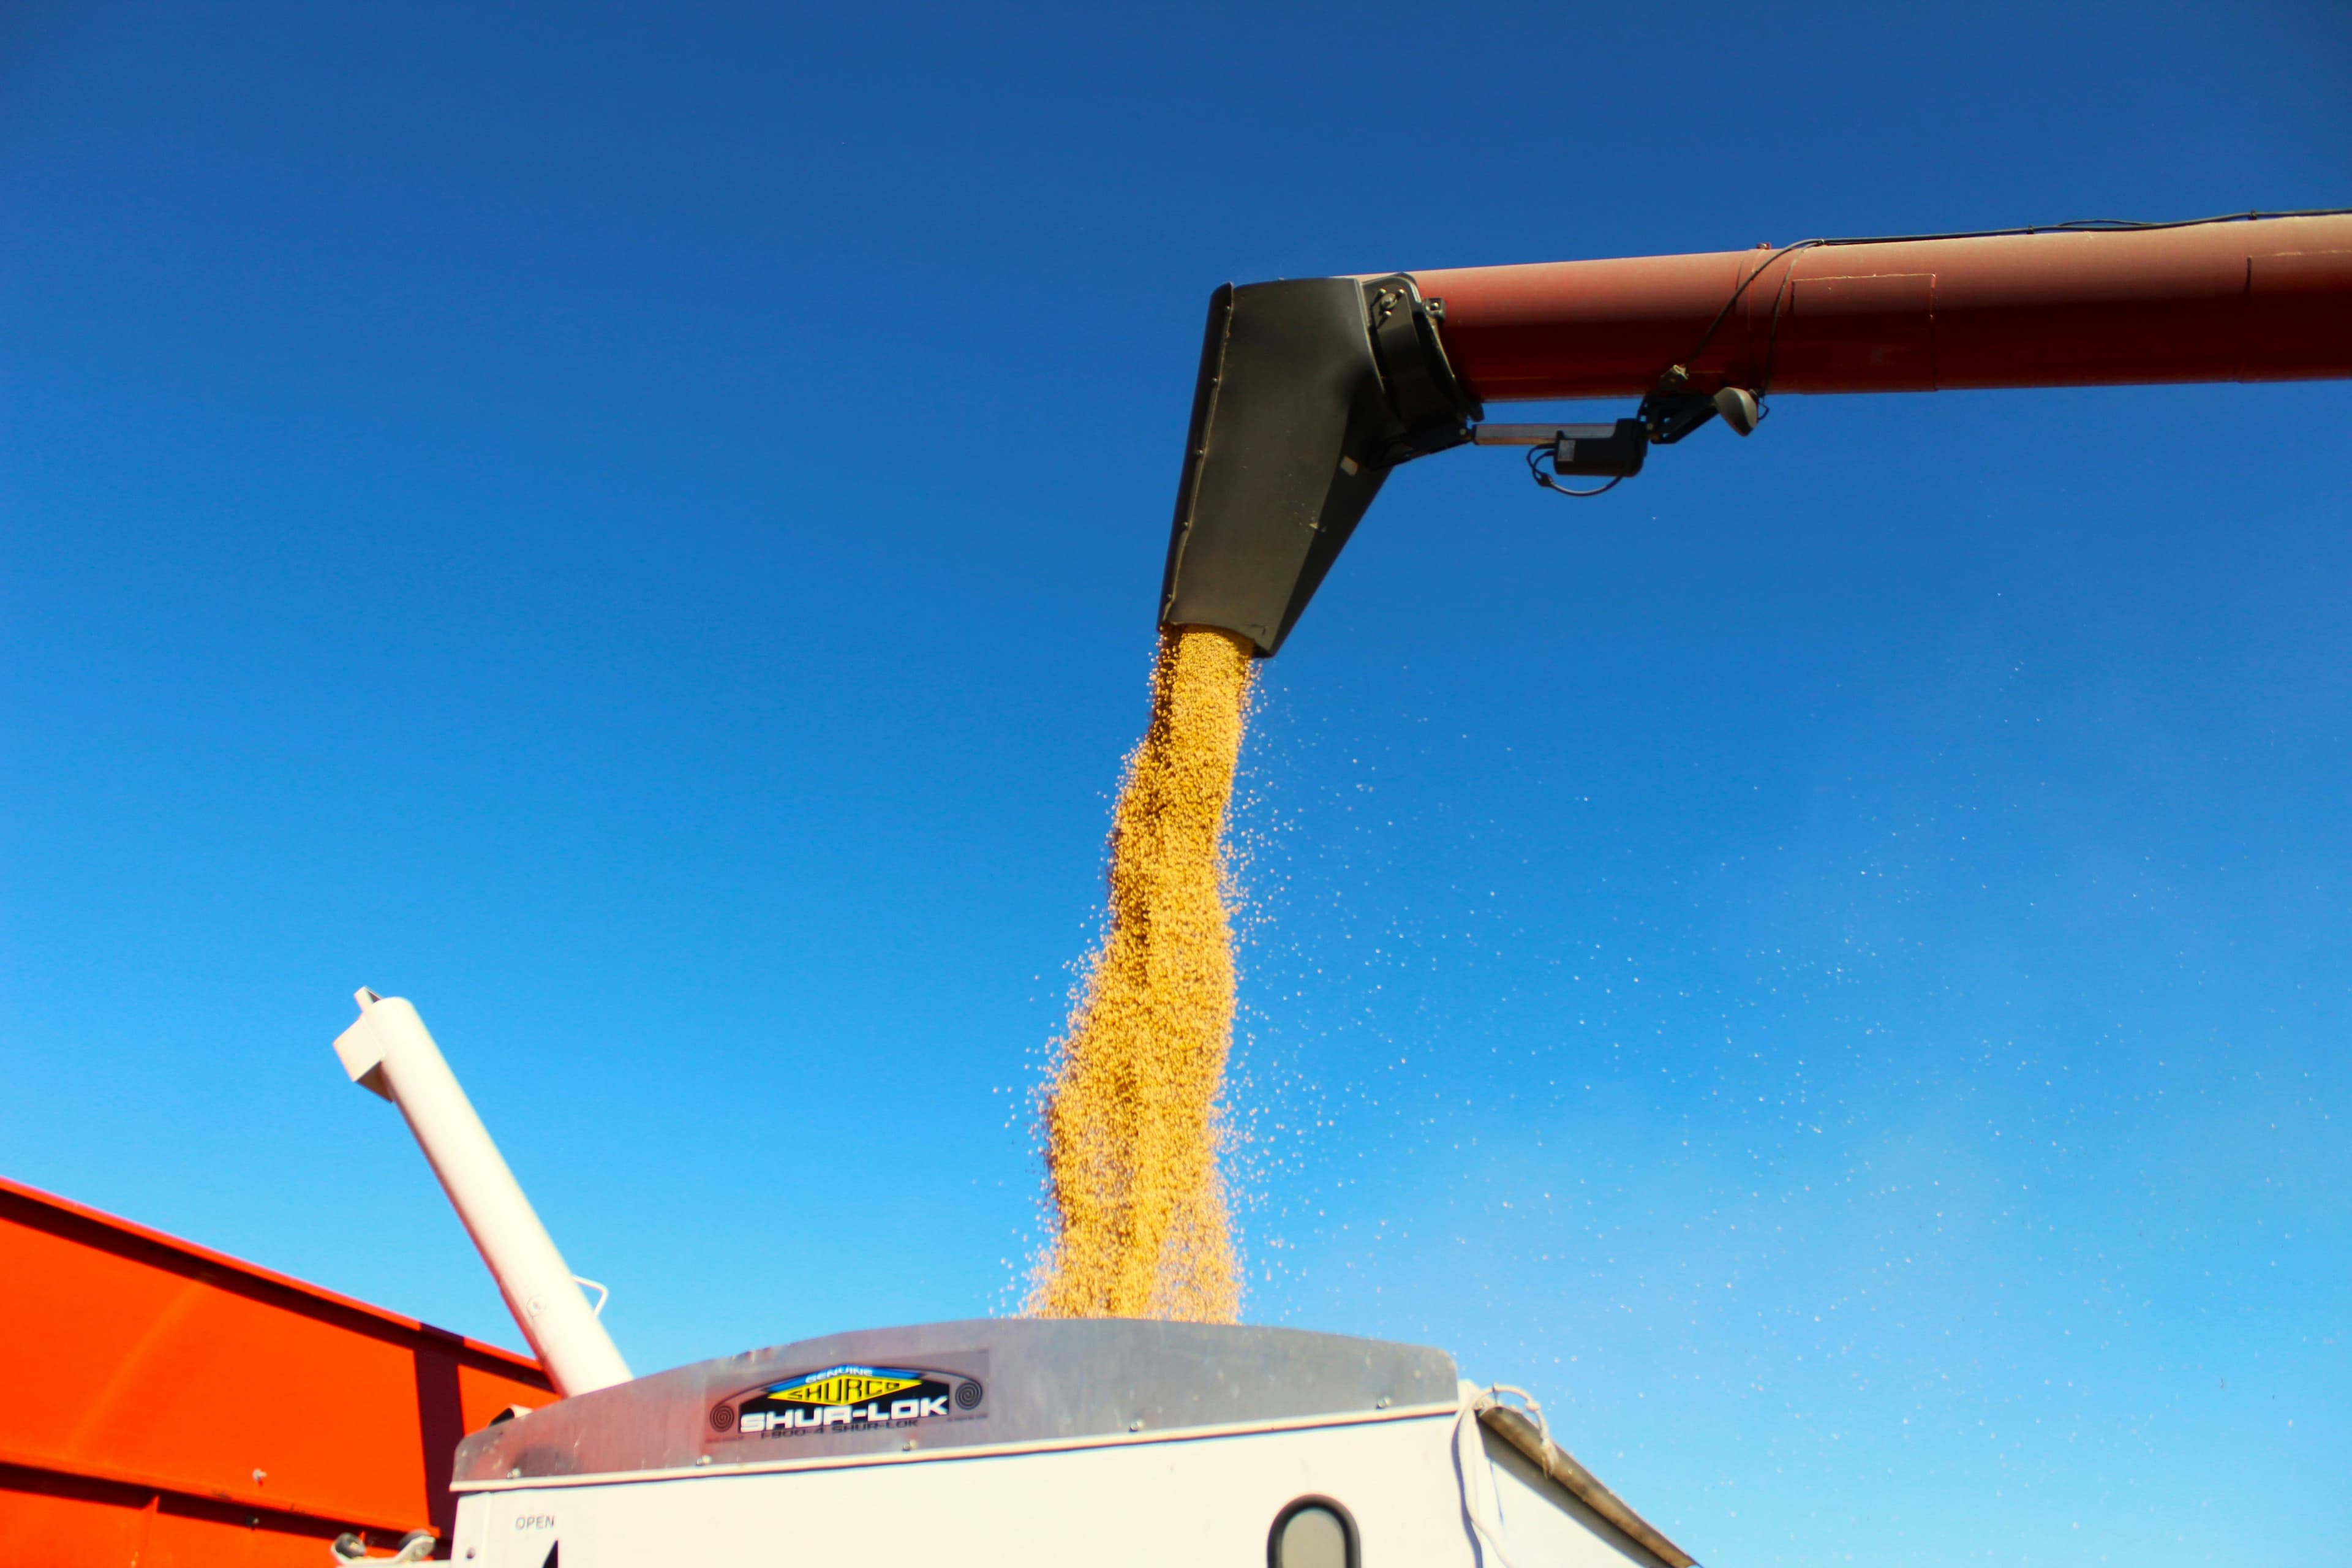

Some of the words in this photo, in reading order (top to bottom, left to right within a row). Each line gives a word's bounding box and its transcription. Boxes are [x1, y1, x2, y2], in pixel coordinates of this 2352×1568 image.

[805, 1366, 873, 1384] GENUINE
[786, 1378, 900, 1404] SHURCO
[740, 1395, 949, 1433] SHUR-LOK
[831, 1419, 918, 1434] SHUR-LOK
[515, 1515, 554, 1530] OPEN
